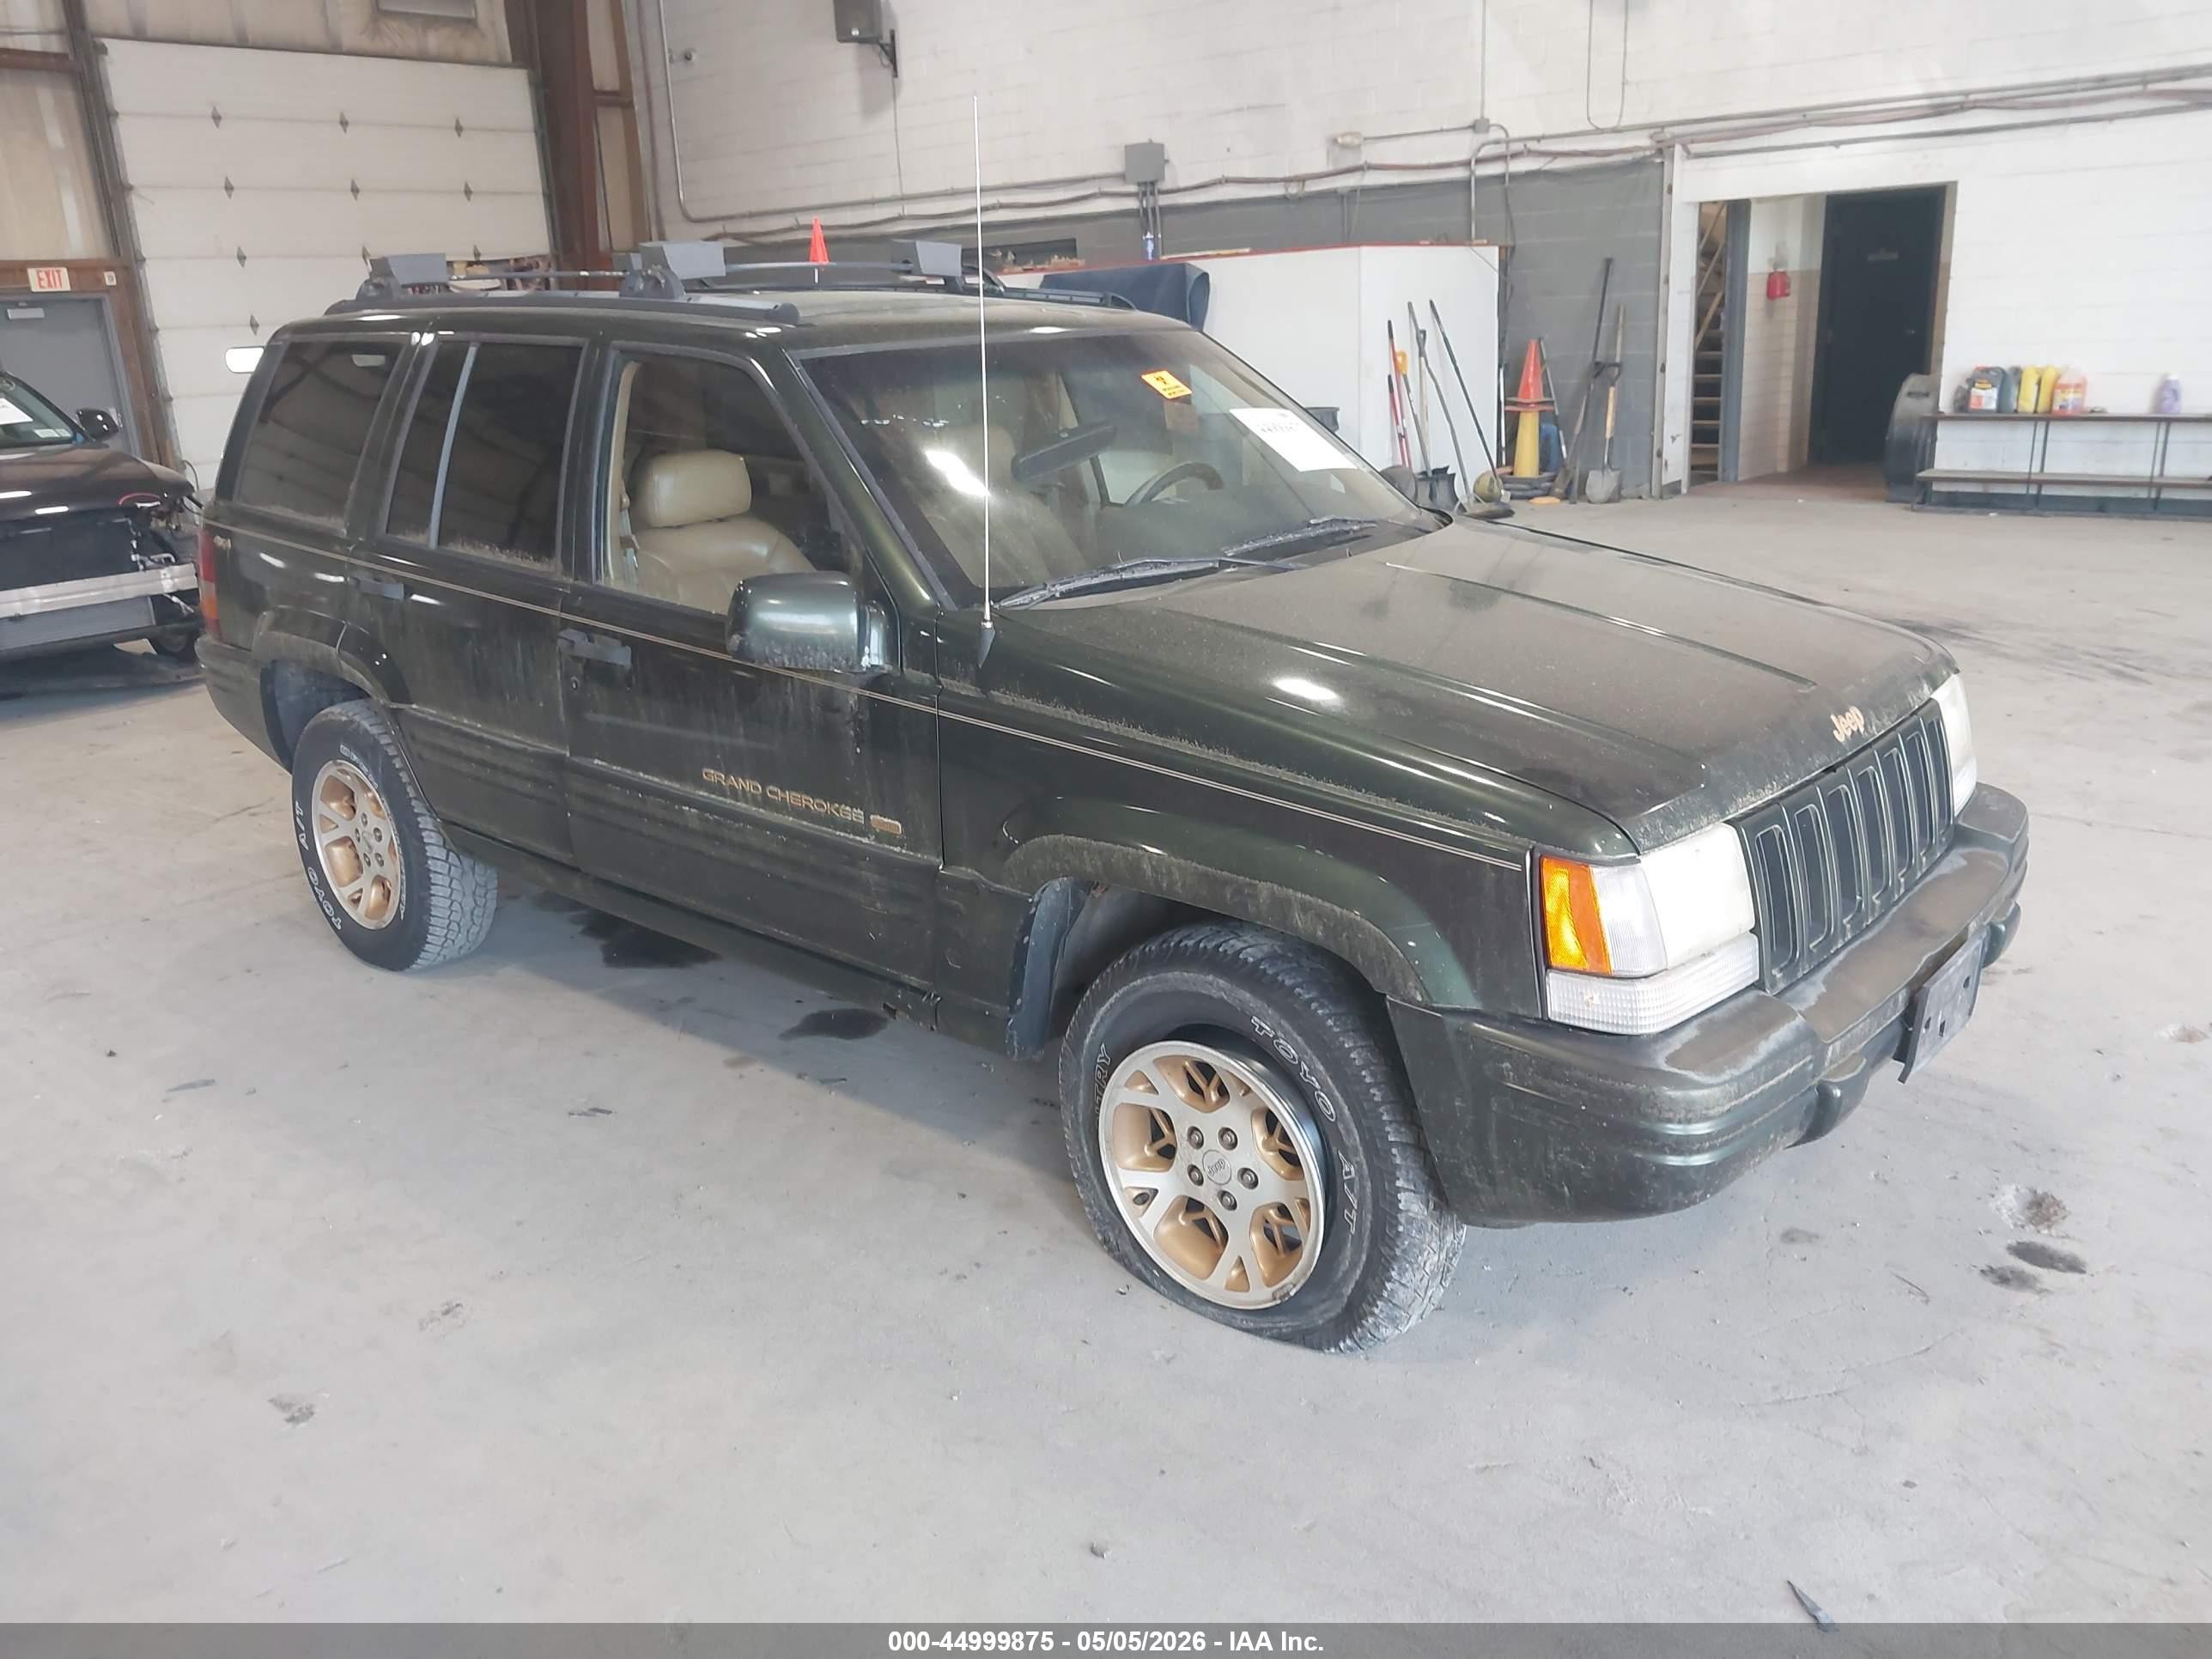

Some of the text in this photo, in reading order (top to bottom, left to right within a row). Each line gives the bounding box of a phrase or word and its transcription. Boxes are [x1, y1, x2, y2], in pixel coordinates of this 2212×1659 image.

[36, 269, 63, 289] EXIT
[1830, 706, 1864, 743] Jeep
[702, 768, 763, 795] GRAND
[767, 785, 864, 825] CHEROKEE
[307, 866, 342, 931] TOYO
[1251, 1016, 1358, 1235] TOYO A/T
